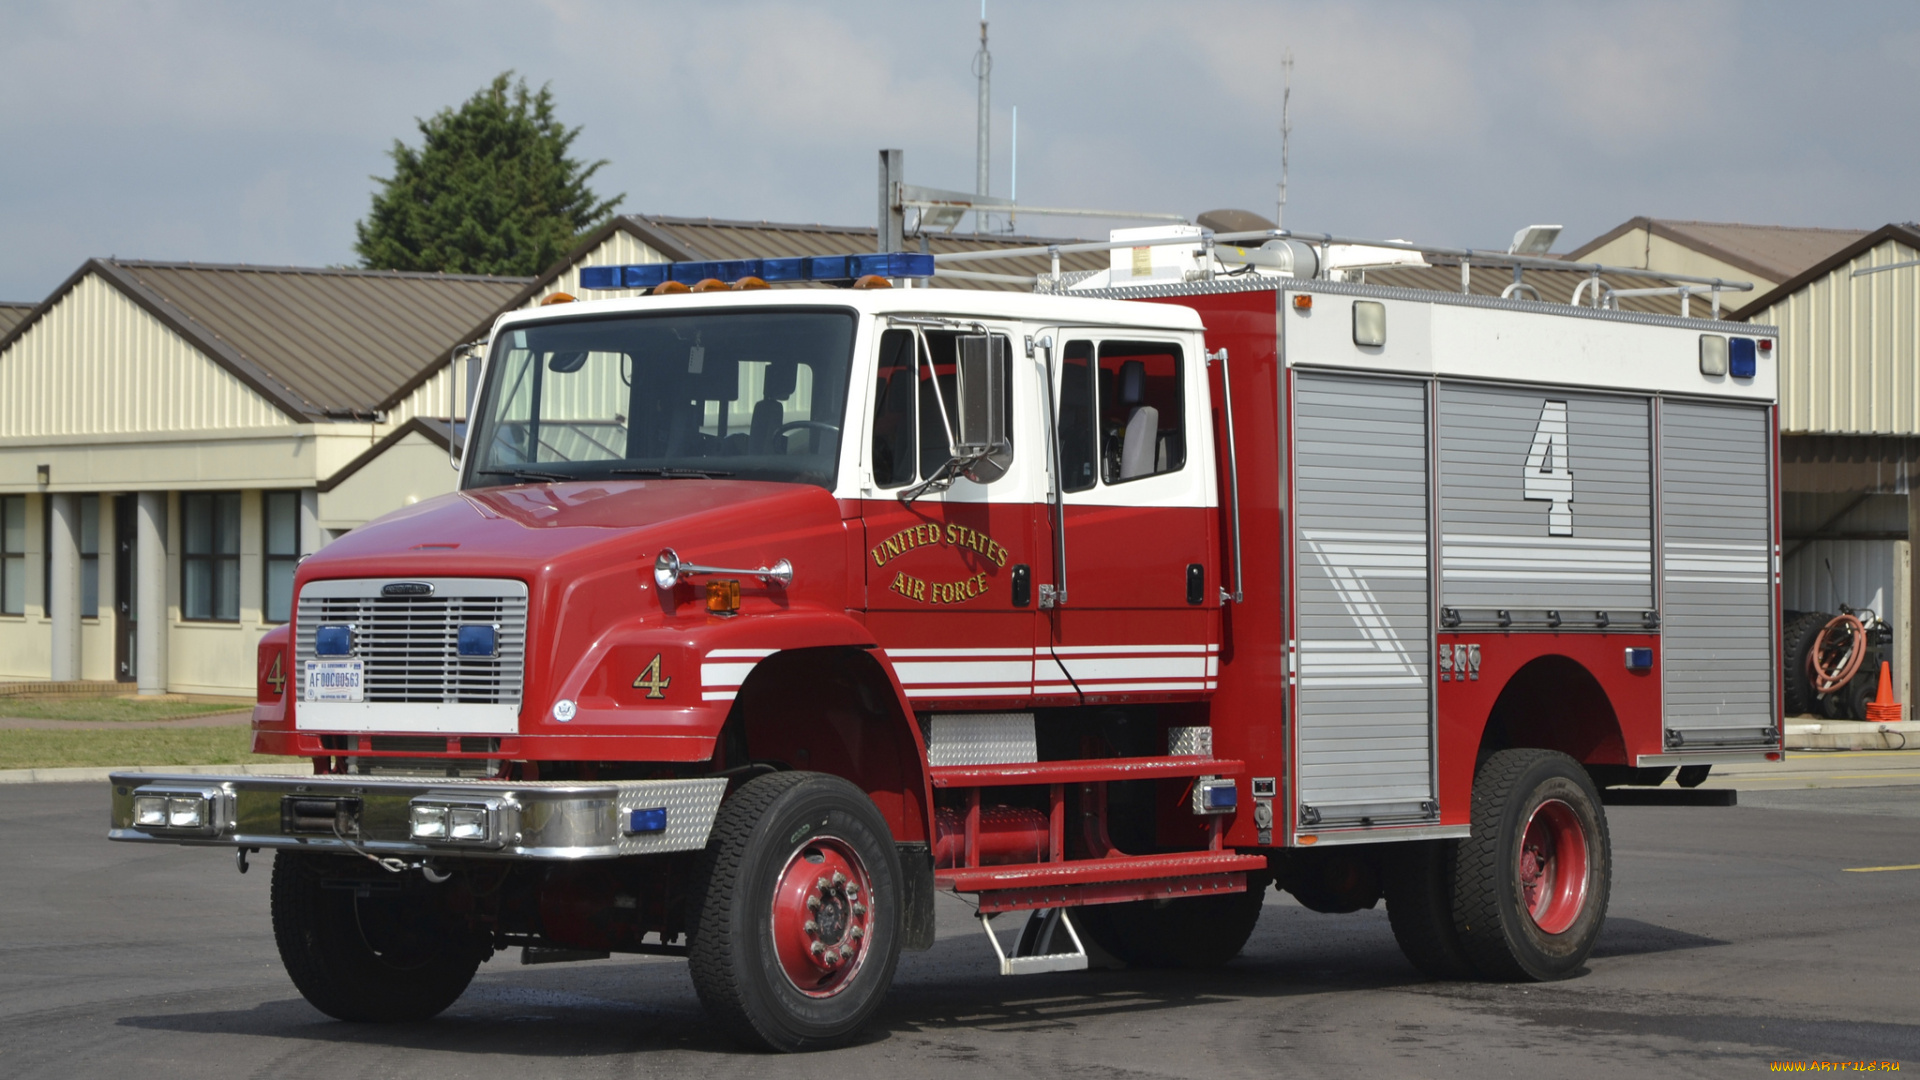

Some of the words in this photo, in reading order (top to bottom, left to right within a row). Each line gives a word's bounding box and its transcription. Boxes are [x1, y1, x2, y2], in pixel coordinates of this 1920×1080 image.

[1523, 399, 1574, 538] 4
[871, 523, 941, 567] UNITED
[946, 523, 1008, 567] STATES
[890, 571, 926, 602] AIR
[930, 572, 989, 604] FORCE
[266, 650, 287, 694] 4
[309, 672, 359, 687] AF00C00563
[632, 653, 671, 699] 4
